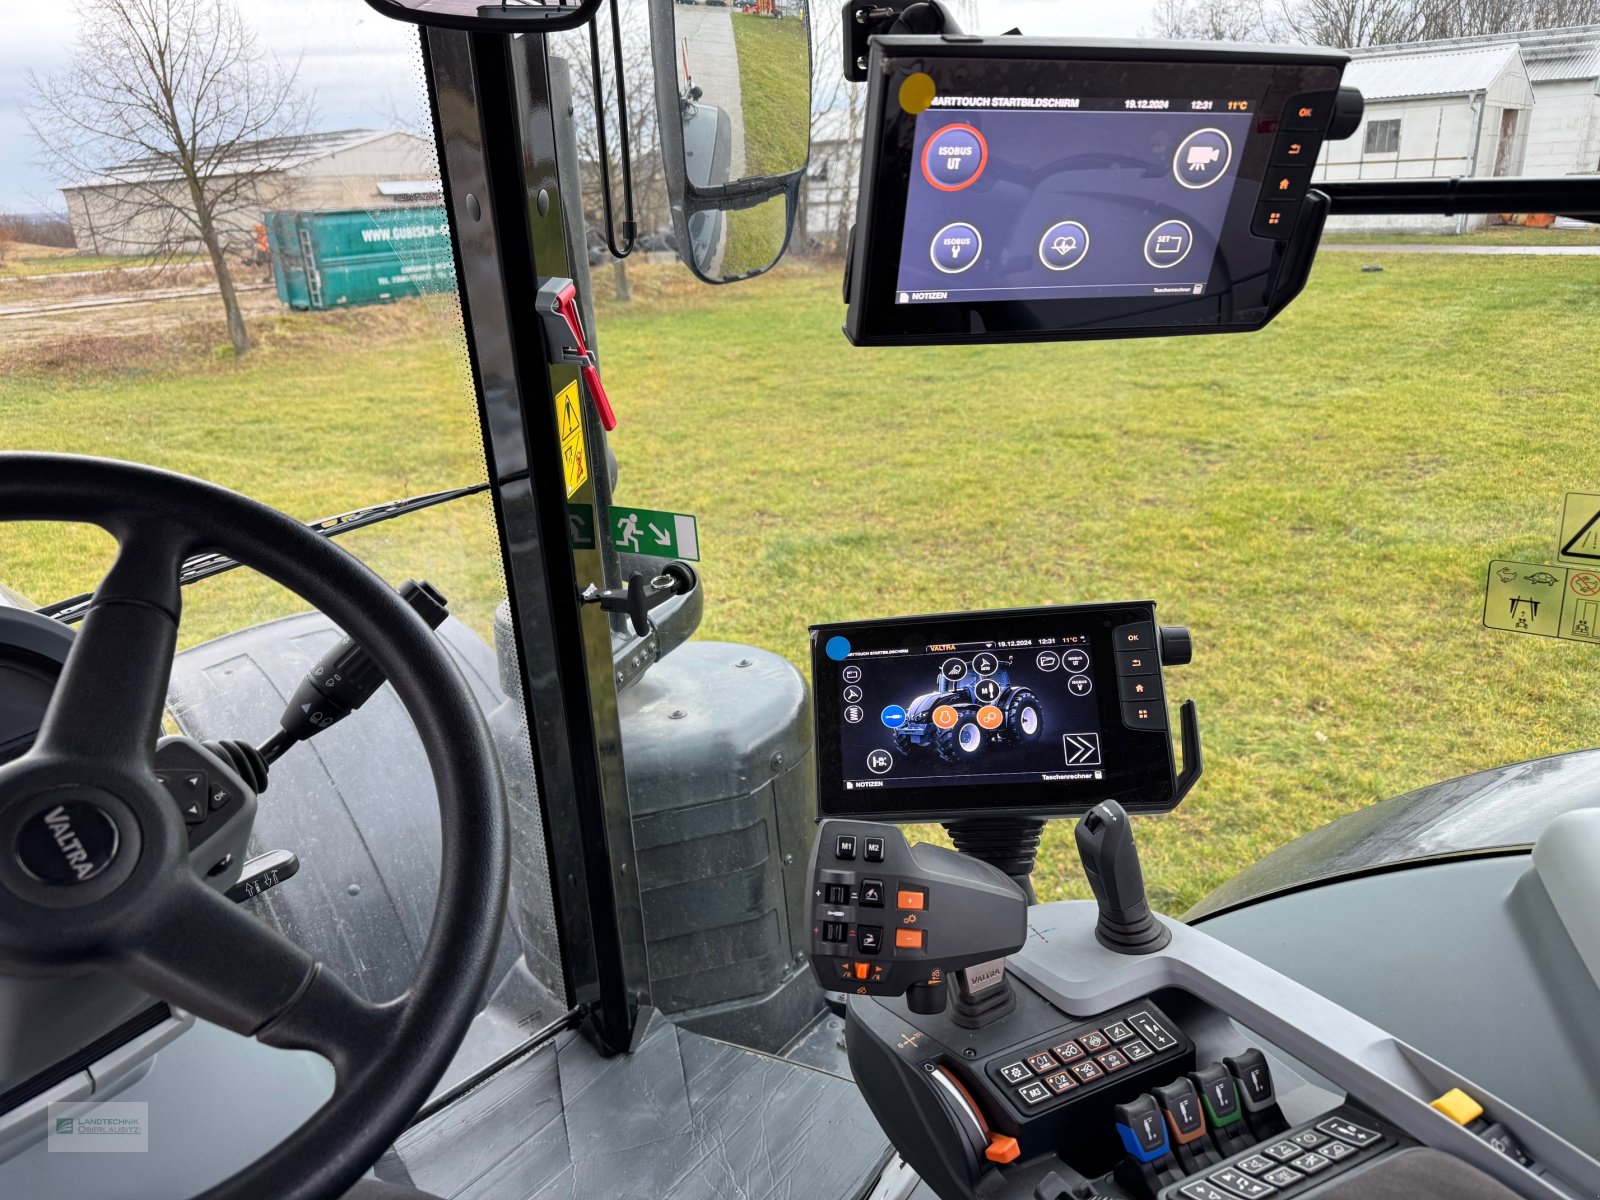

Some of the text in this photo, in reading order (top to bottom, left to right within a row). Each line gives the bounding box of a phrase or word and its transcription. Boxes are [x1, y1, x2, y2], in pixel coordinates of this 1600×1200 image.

[991, 97, 1079, 108] STARTBILDSCHIRM
[1124, 99, 1169, 109] 19.12.2024
[1191, 100, 1213, 110] 12:31
[1298, 108, 1313, 117] OK
[938, 146, 973, 156] ISOBUS
[947, 158, 961, 170] UT
[912, 292, 948, 300] NOTIZEN
[930, 644, 956, 652] VALTRA
[998, 639, 1032, 647] 19.12.2024
[1042, 773, 1092, 781] Taschenrechner
[213, 789, 227, 802] OK
[43, 806, 96, 880] VALTRA
[841, 842, 852, 850] M1
[868, 843, 880, 852] M2
[1029, 1088, 1042, 1098] M3
